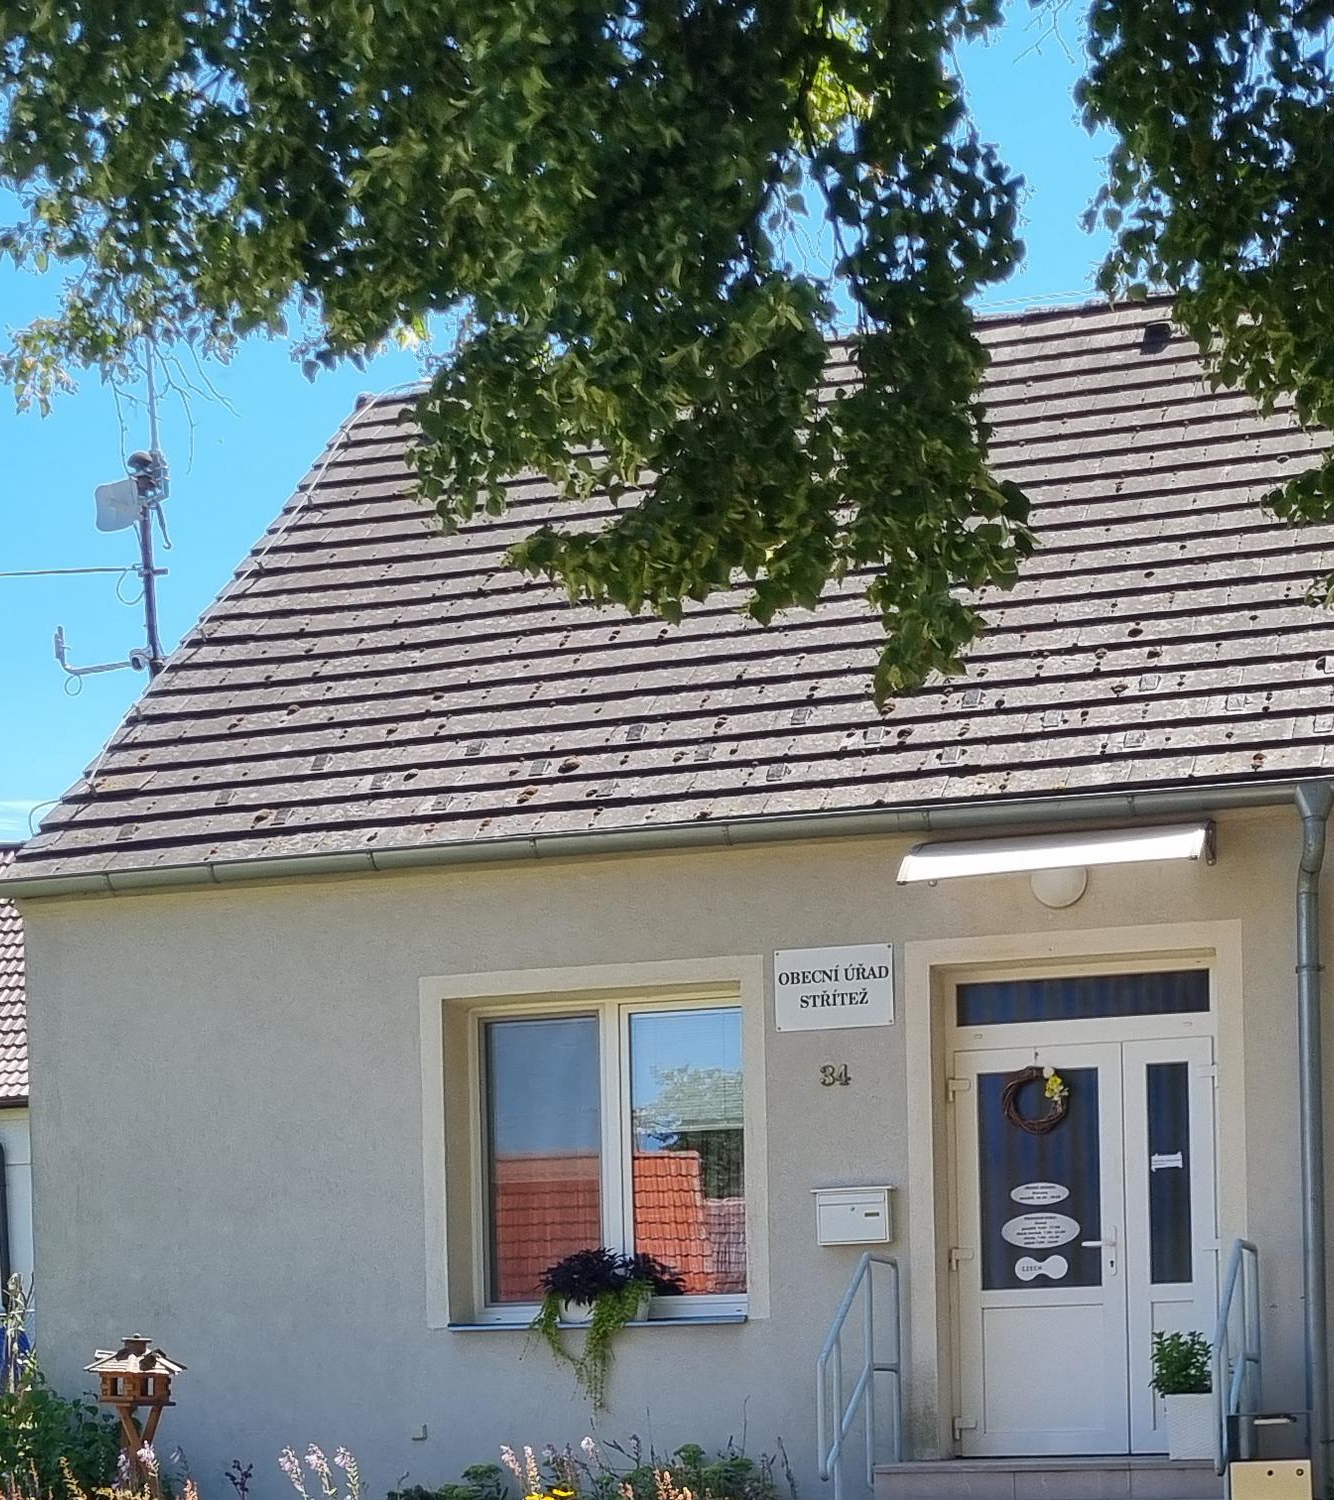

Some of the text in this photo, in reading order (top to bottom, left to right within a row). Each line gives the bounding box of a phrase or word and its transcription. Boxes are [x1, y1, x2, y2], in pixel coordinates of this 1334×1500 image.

[778, 963, 890, 986] OBECNÍ ÚŘAD
[799, 988, 869, 1009] STŘÍTEŽ
[819, 1064, 852, 1087] 34
